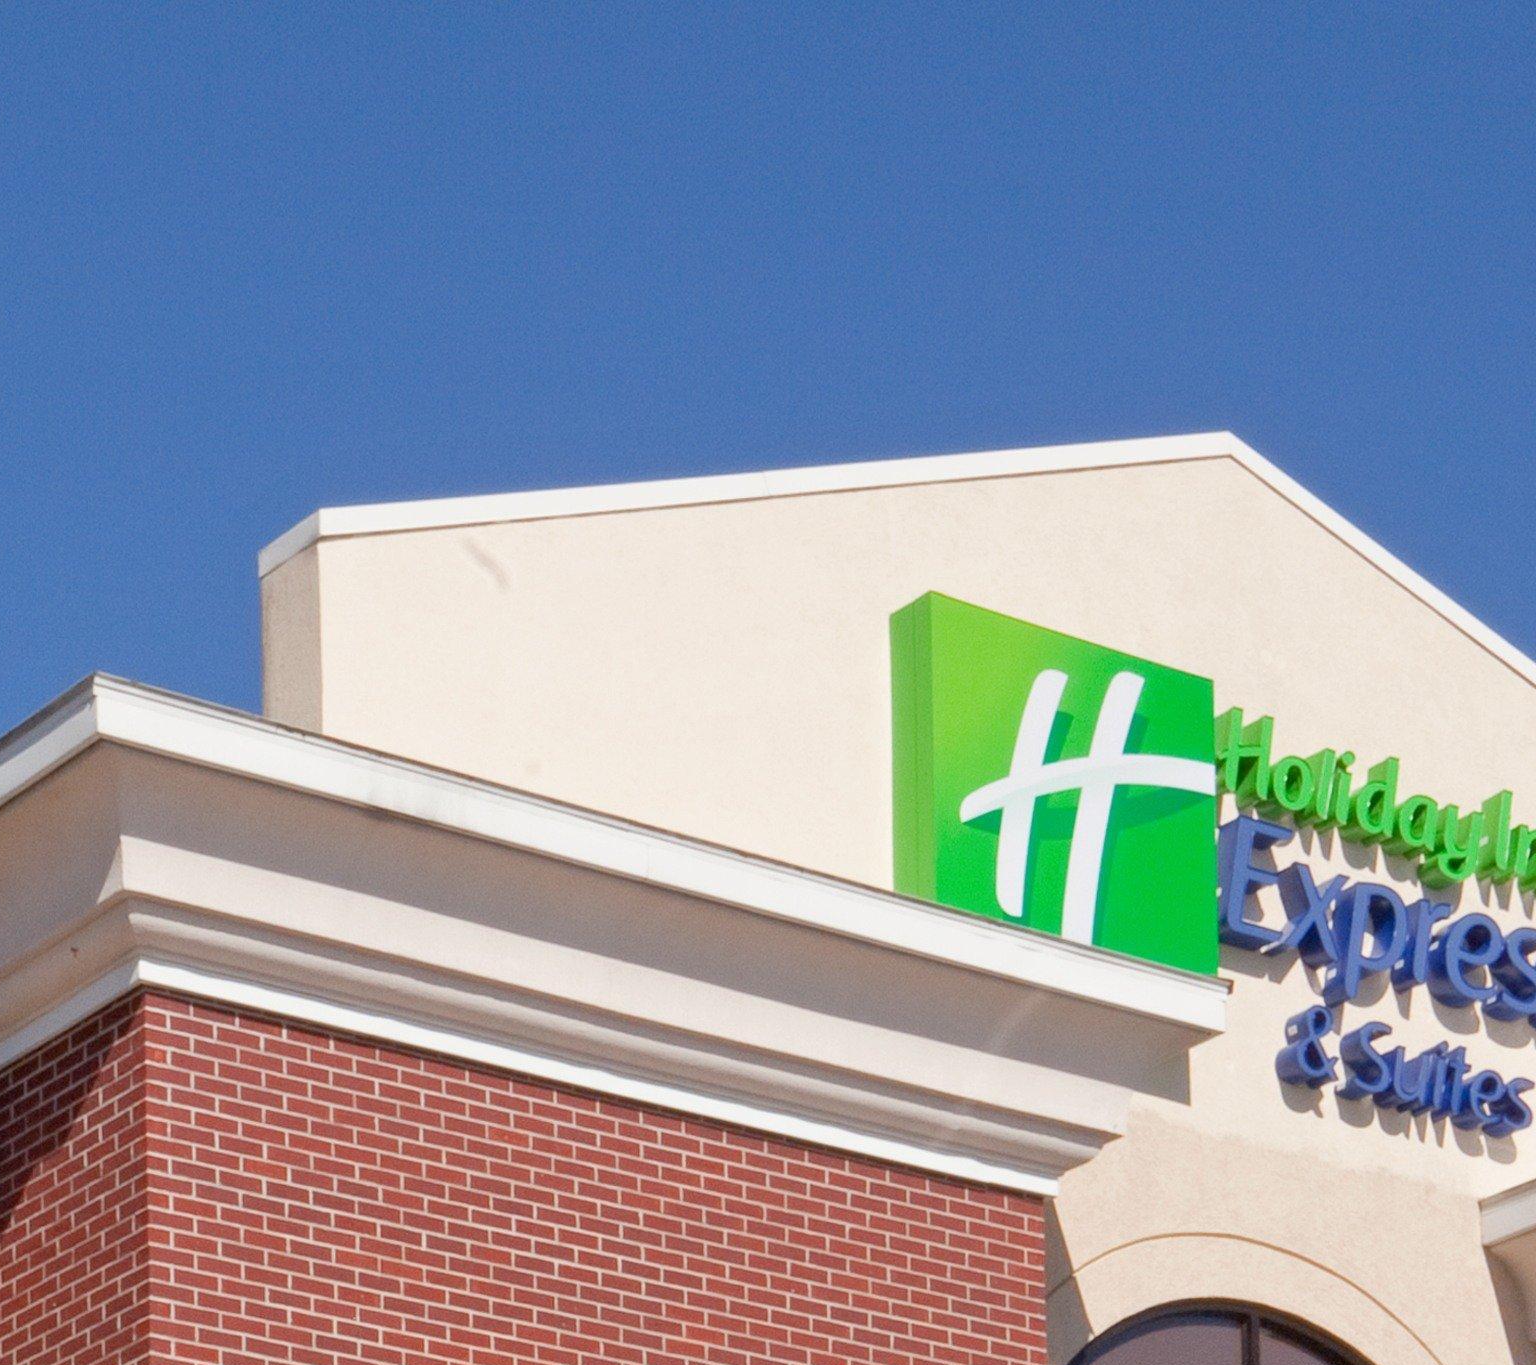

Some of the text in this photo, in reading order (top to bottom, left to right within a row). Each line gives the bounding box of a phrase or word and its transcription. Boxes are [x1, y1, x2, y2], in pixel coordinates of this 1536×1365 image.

[1217, 707, 1481, 887] Holiday
[1275, 1004, 1533, 1137] & Suites
